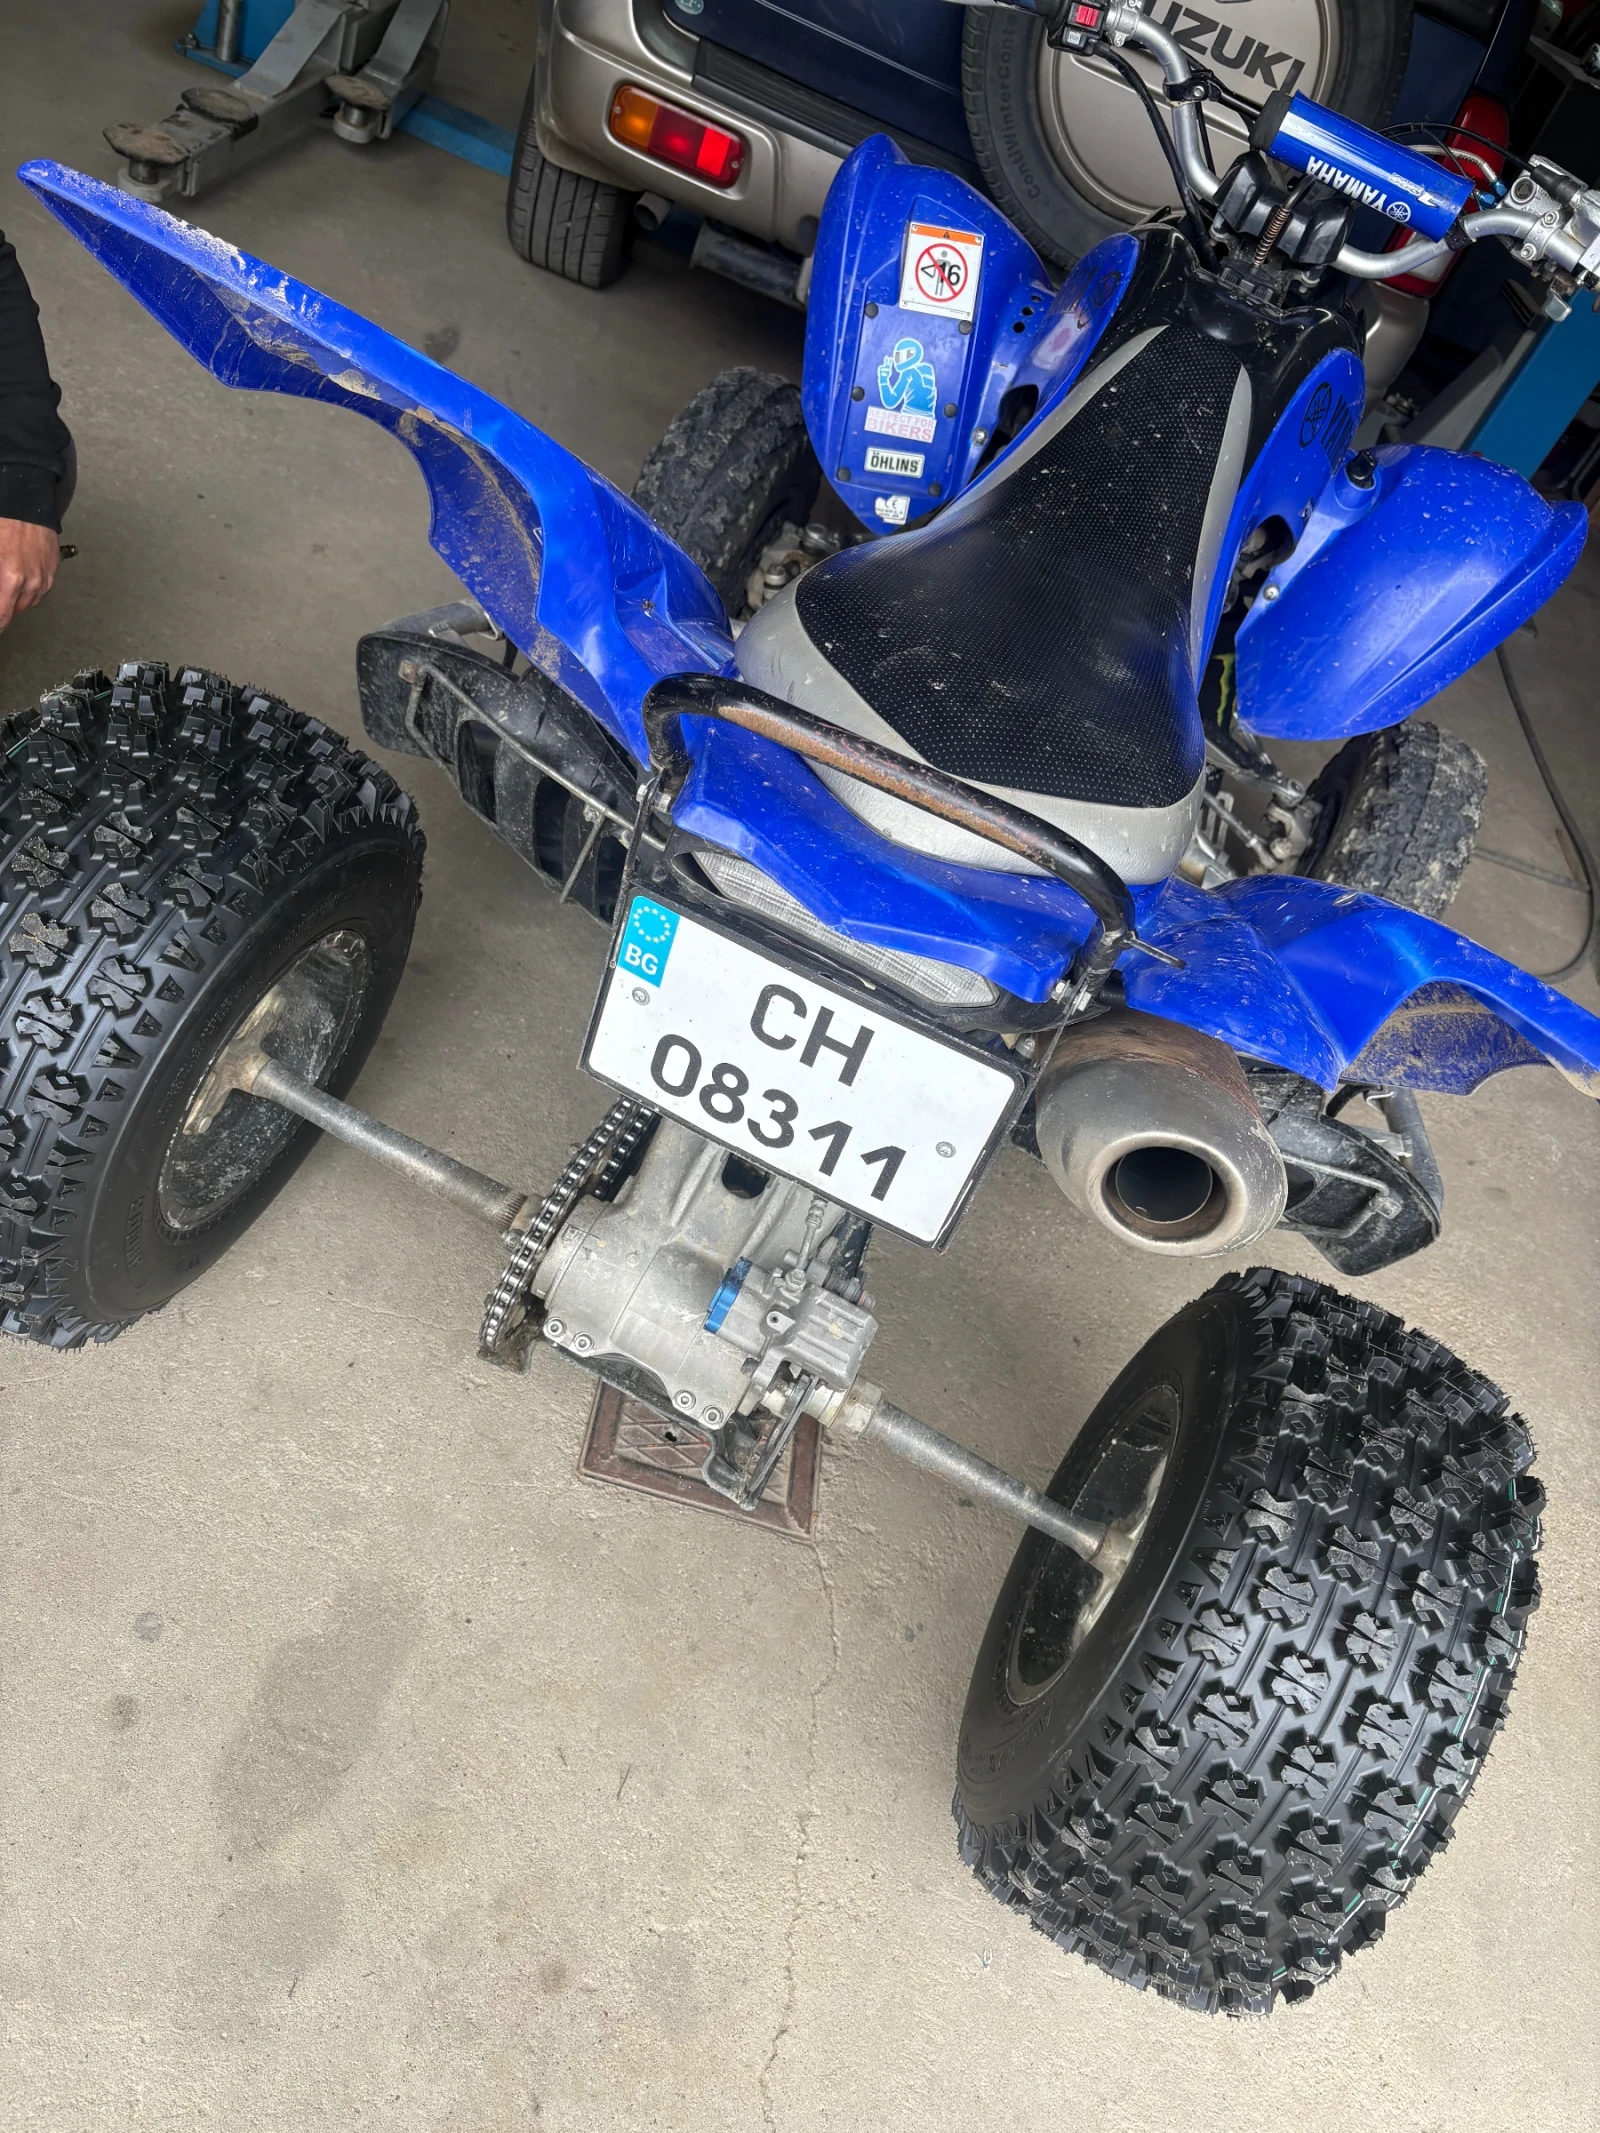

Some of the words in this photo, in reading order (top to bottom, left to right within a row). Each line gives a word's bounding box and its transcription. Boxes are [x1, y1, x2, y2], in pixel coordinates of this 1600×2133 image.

[1143, 0, 1306, 95] UZUKI
[1305, 155, 1388, 213] YAMAHA
[867, 417, 933, 442] BIKERS
[868, 408, 913, 425] RESPECT
[914, 416, 934, 430] FOR
[870, 450, 919, 474] ÖHLINS
[624, 941, 660, 976] BG
[750, 983, 875, 1088] CH
[650, 1033, 907, 1202] 08311
